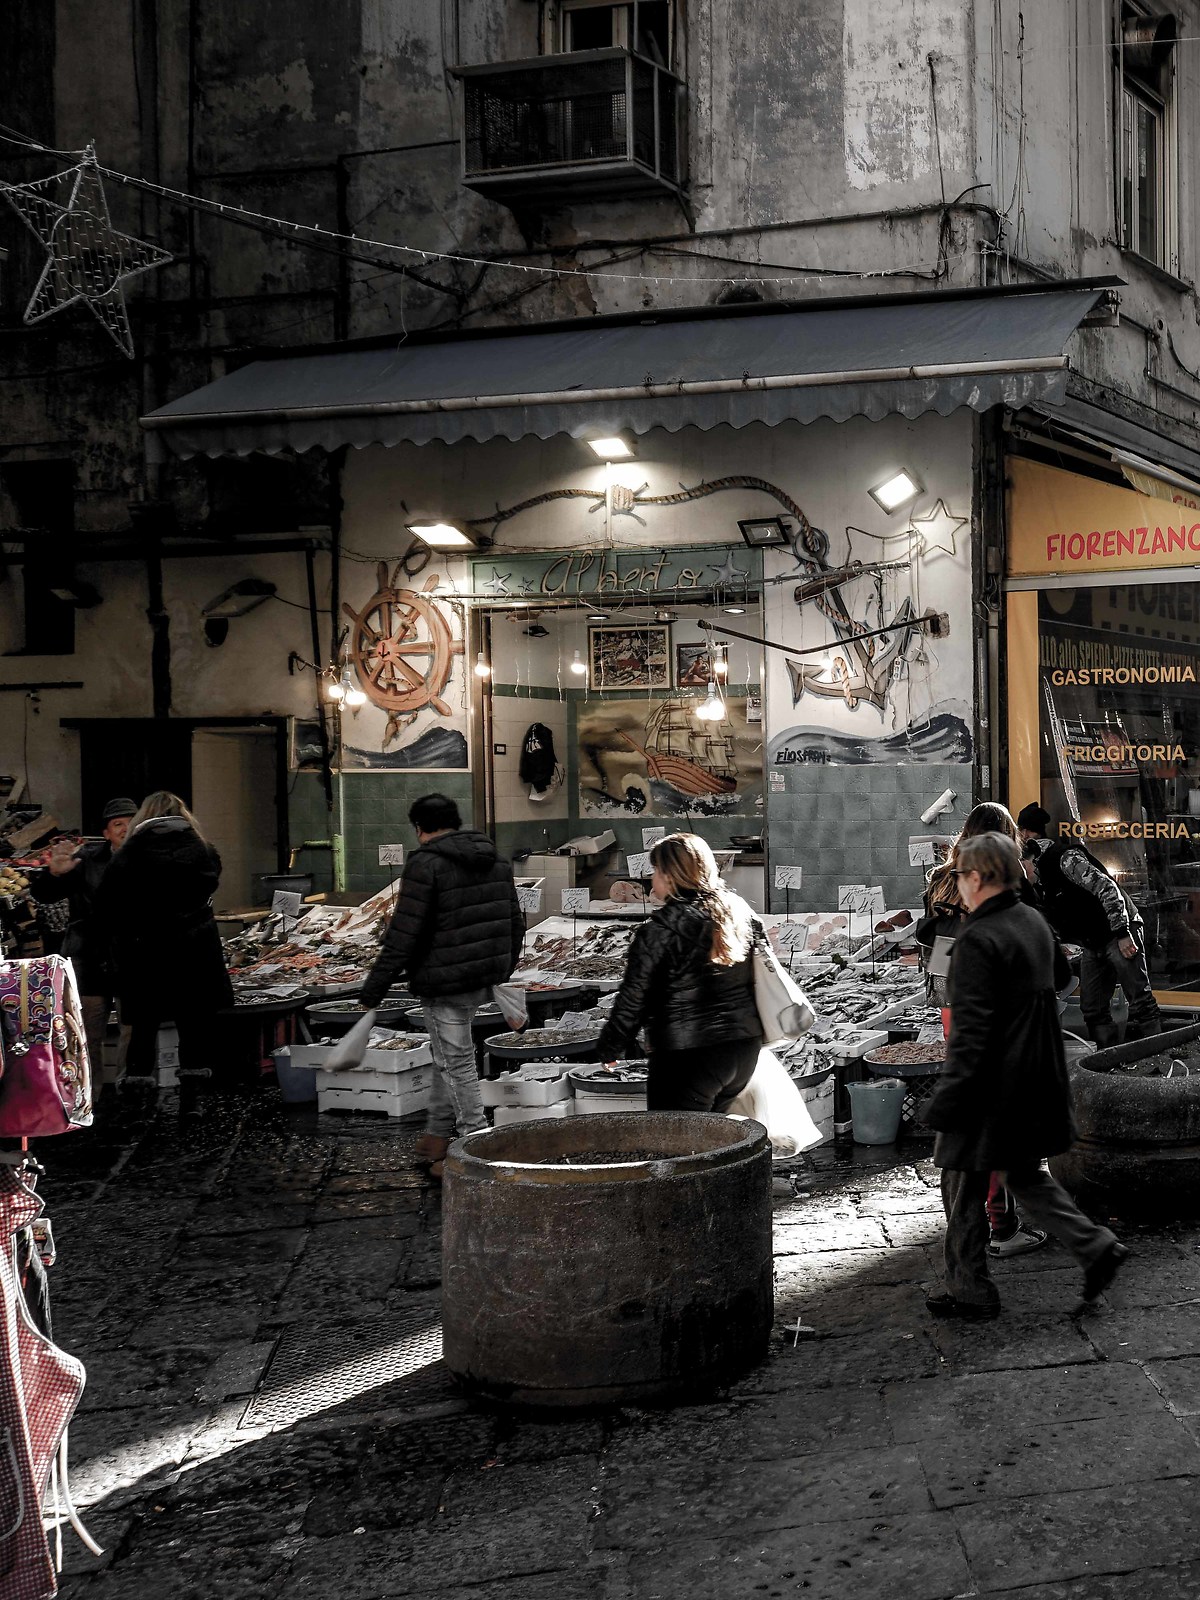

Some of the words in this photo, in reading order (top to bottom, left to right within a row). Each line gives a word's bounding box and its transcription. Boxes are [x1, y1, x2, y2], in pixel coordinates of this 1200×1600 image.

[1051, 666, 1196, 686] GASTRONOMIA
[1062, 744, 1186, 762] FRIGGITORIA
[1058, 822, 1190, 839] ROSTICCERIA
